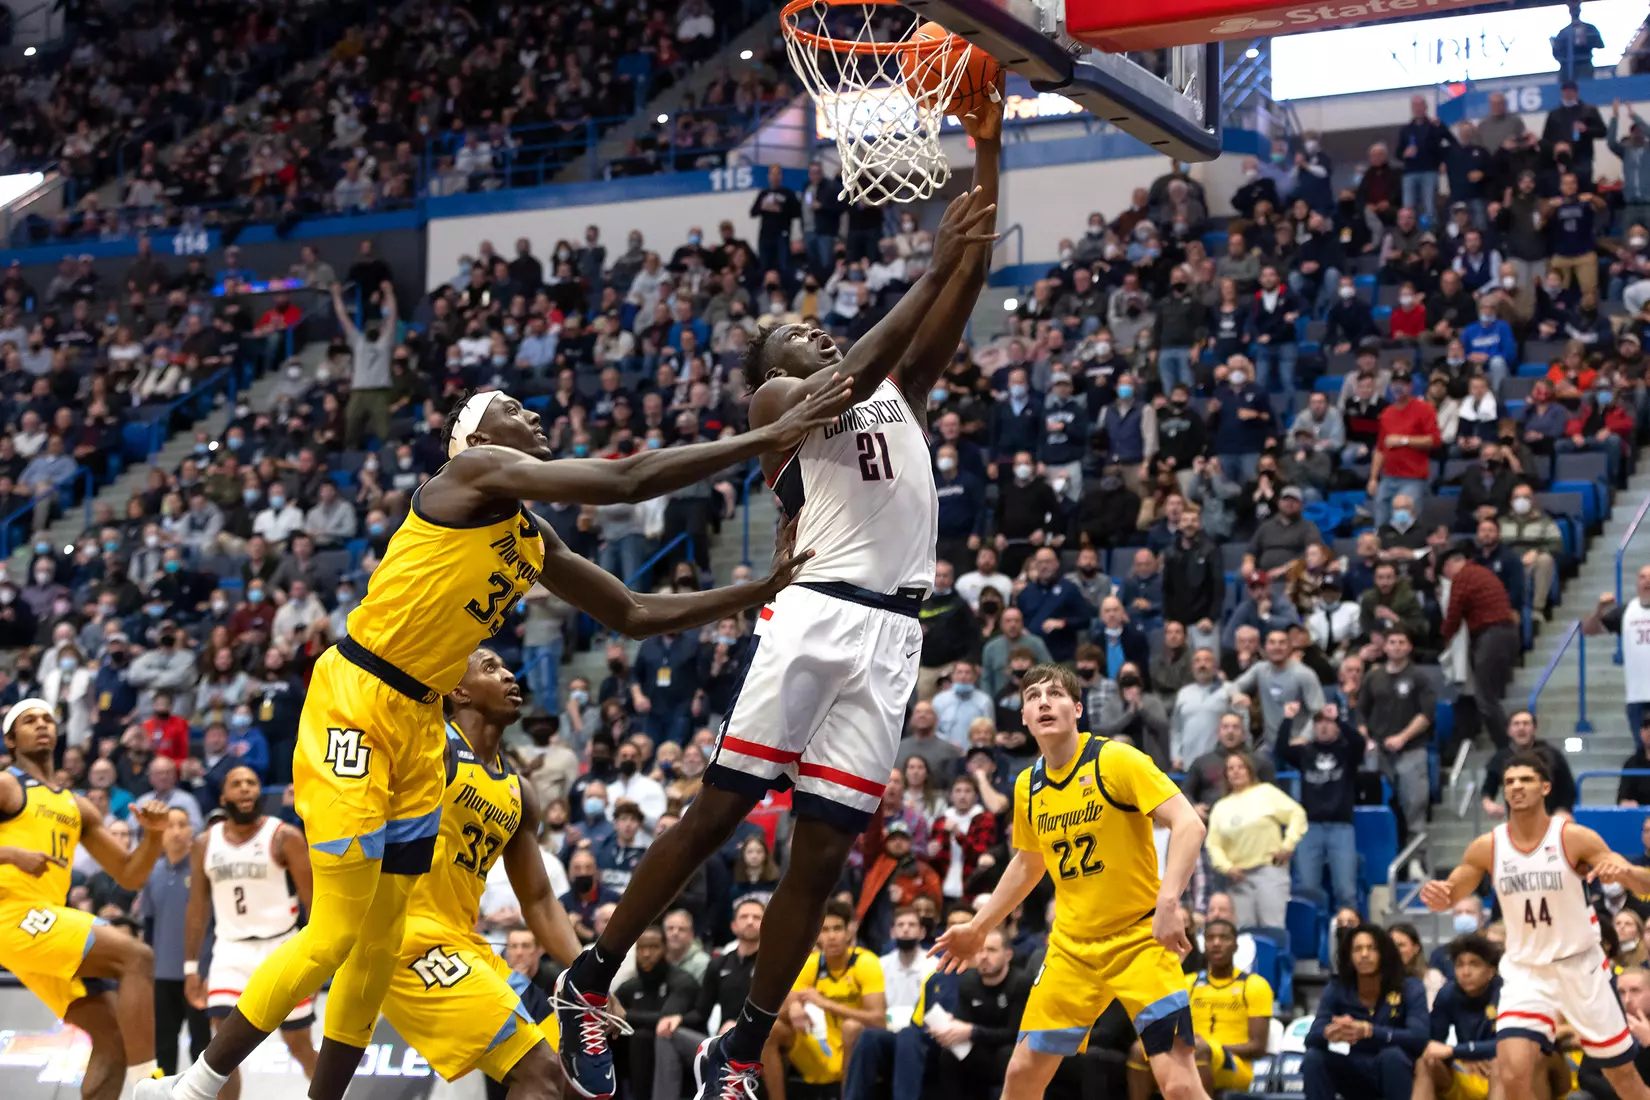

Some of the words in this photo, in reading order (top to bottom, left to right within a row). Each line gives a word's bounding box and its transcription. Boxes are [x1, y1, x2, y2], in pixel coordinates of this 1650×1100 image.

[708, 167, 753, 191] 115
[173, 232, 209, 255] 114
[856, 432, 895, 481] 21
[324, 727, 372, 779] MU
[1036, 800, 1104, 836] Marquette
[453, 821, 503, 881] 32
[1051, 832, 1105, 881] 22
[233, 885, 248, 916] 2
[1499, 871, 1564, 897] CONNECTICUT
[1524, 896, 1553, 929] 44
[407, 944, 472, 992] MU
